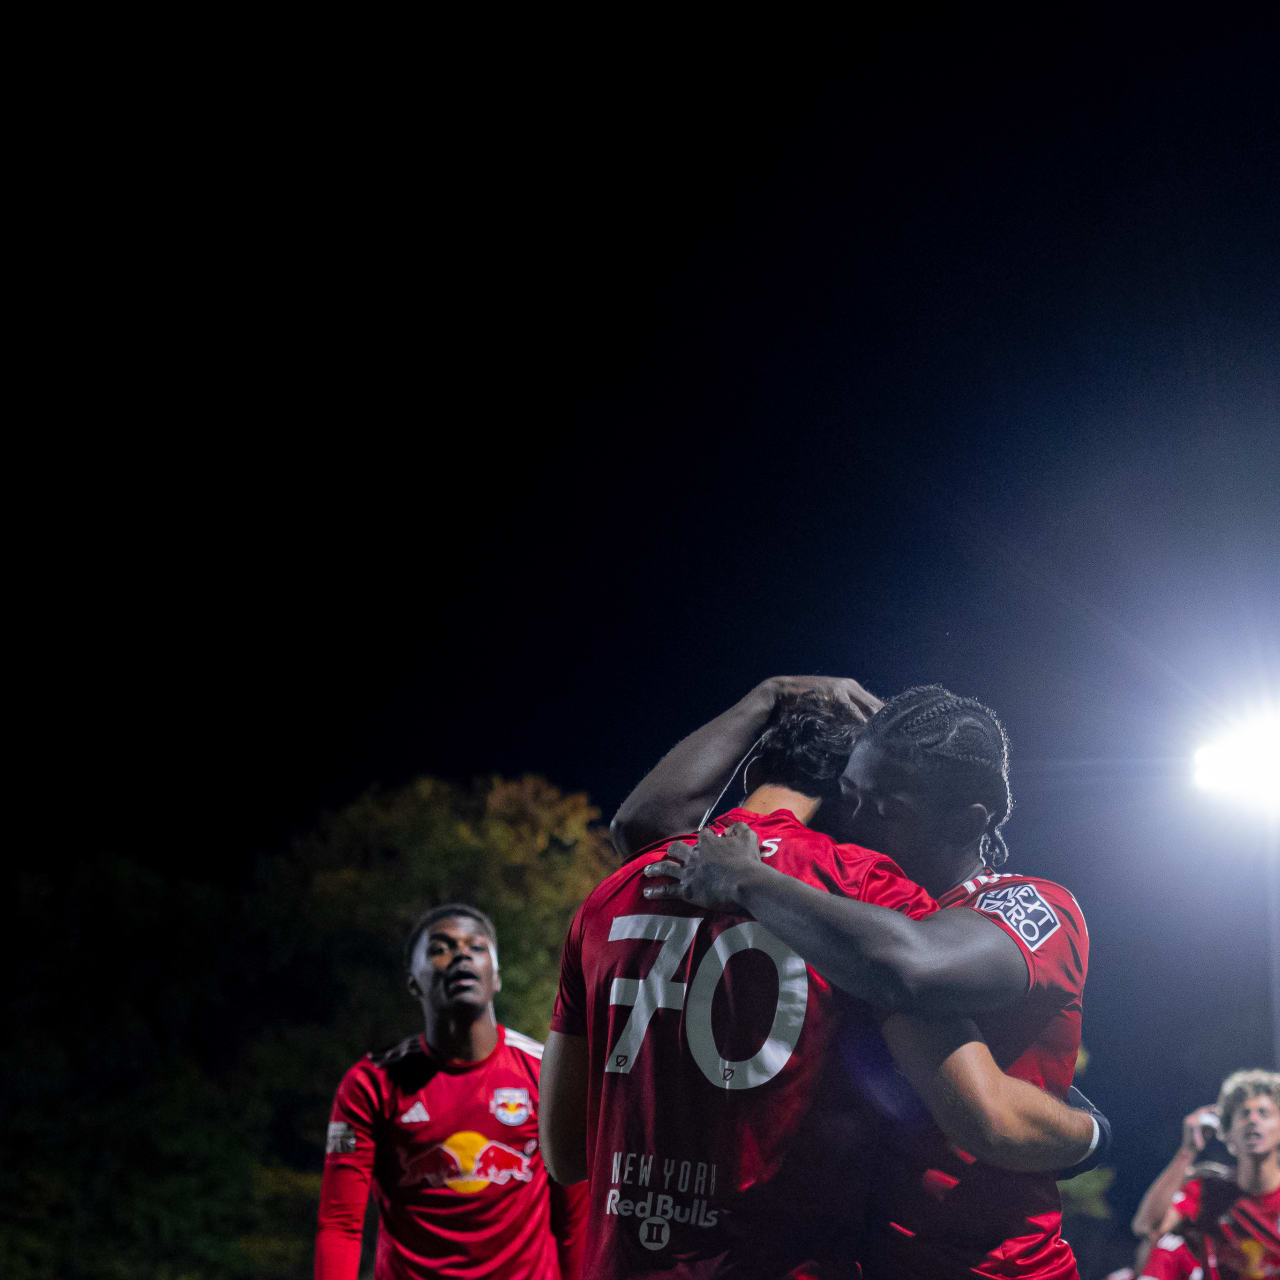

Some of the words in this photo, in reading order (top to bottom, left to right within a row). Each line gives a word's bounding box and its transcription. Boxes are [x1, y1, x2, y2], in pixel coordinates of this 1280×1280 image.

[996, 886, 1055, 927] NEXT
[1000, 898, 1040, 942] PRO
[605, 913, 809, 1090] 70
[611, 1151, 654, 1188] NEW
